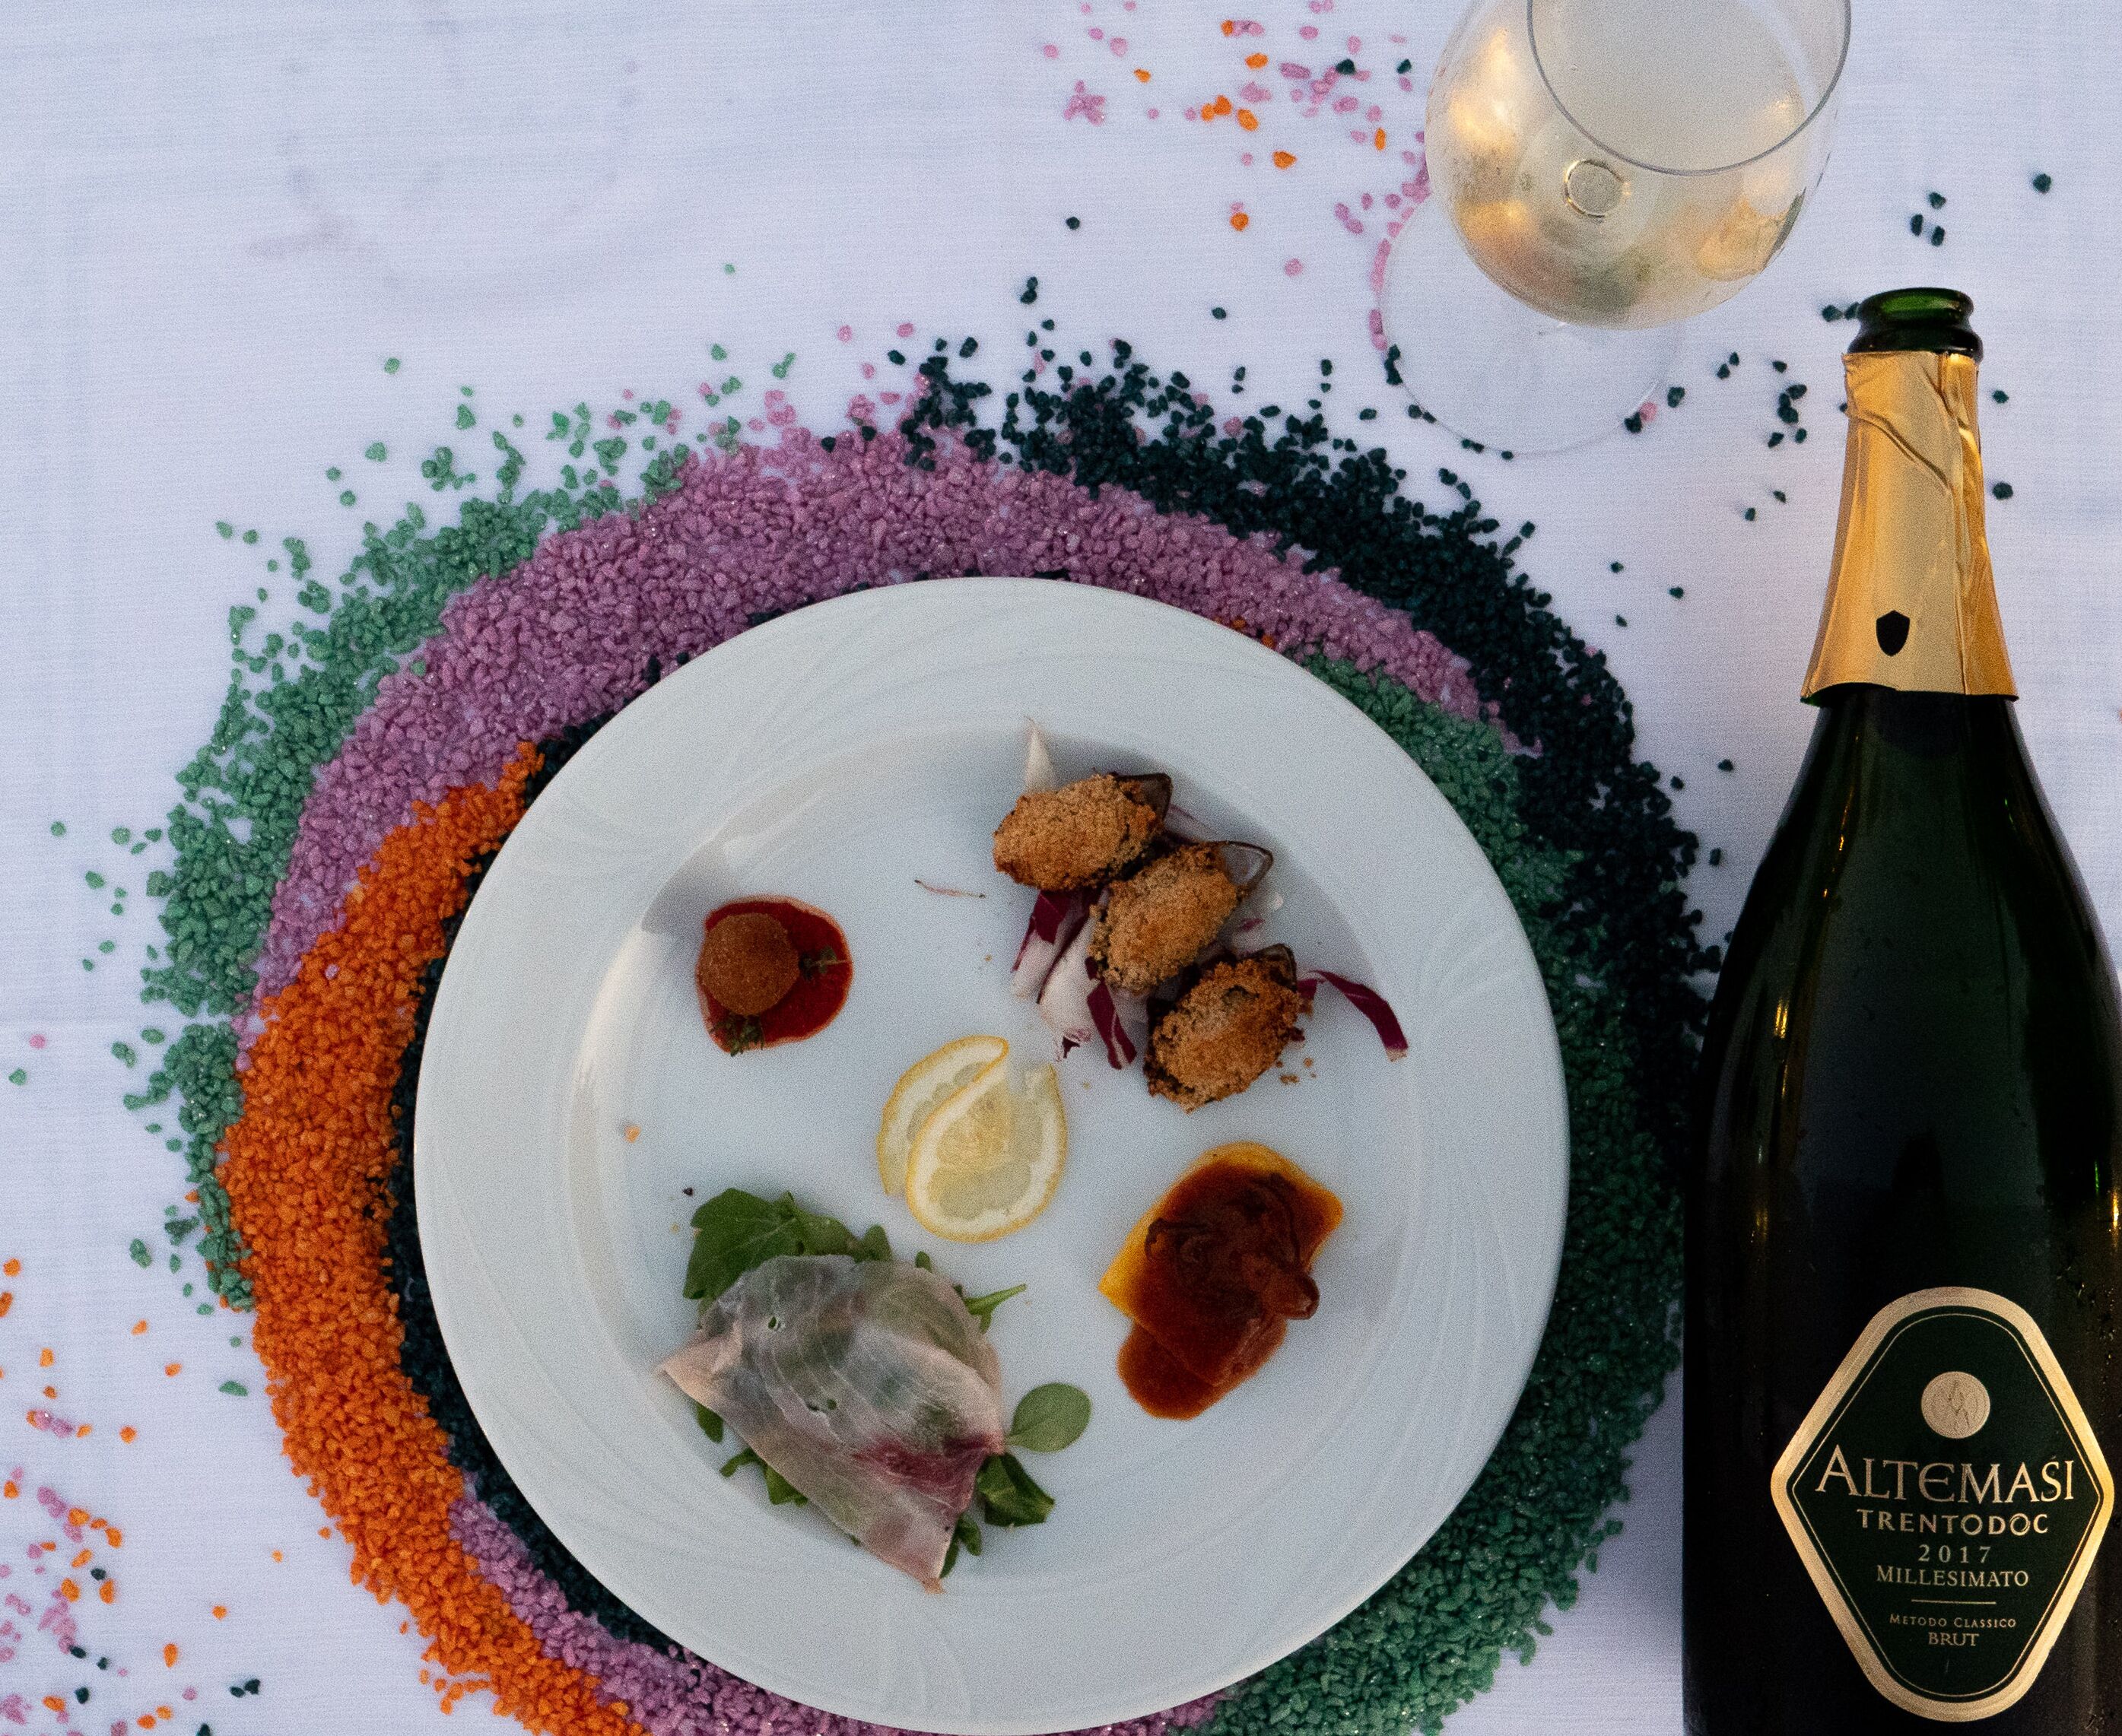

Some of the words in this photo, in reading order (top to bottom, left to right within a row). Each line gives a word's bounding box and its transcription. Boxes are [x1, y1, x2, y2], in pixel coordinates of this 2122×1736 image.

[1857, 1509, 2048, 1536] TRENTODOC
[1917, 1544, 1991, 1563] 2017
[1876, 1564, 2029, 1588] MILLESIMATO
[1928, 1632, 1980, 1647] BRUT
